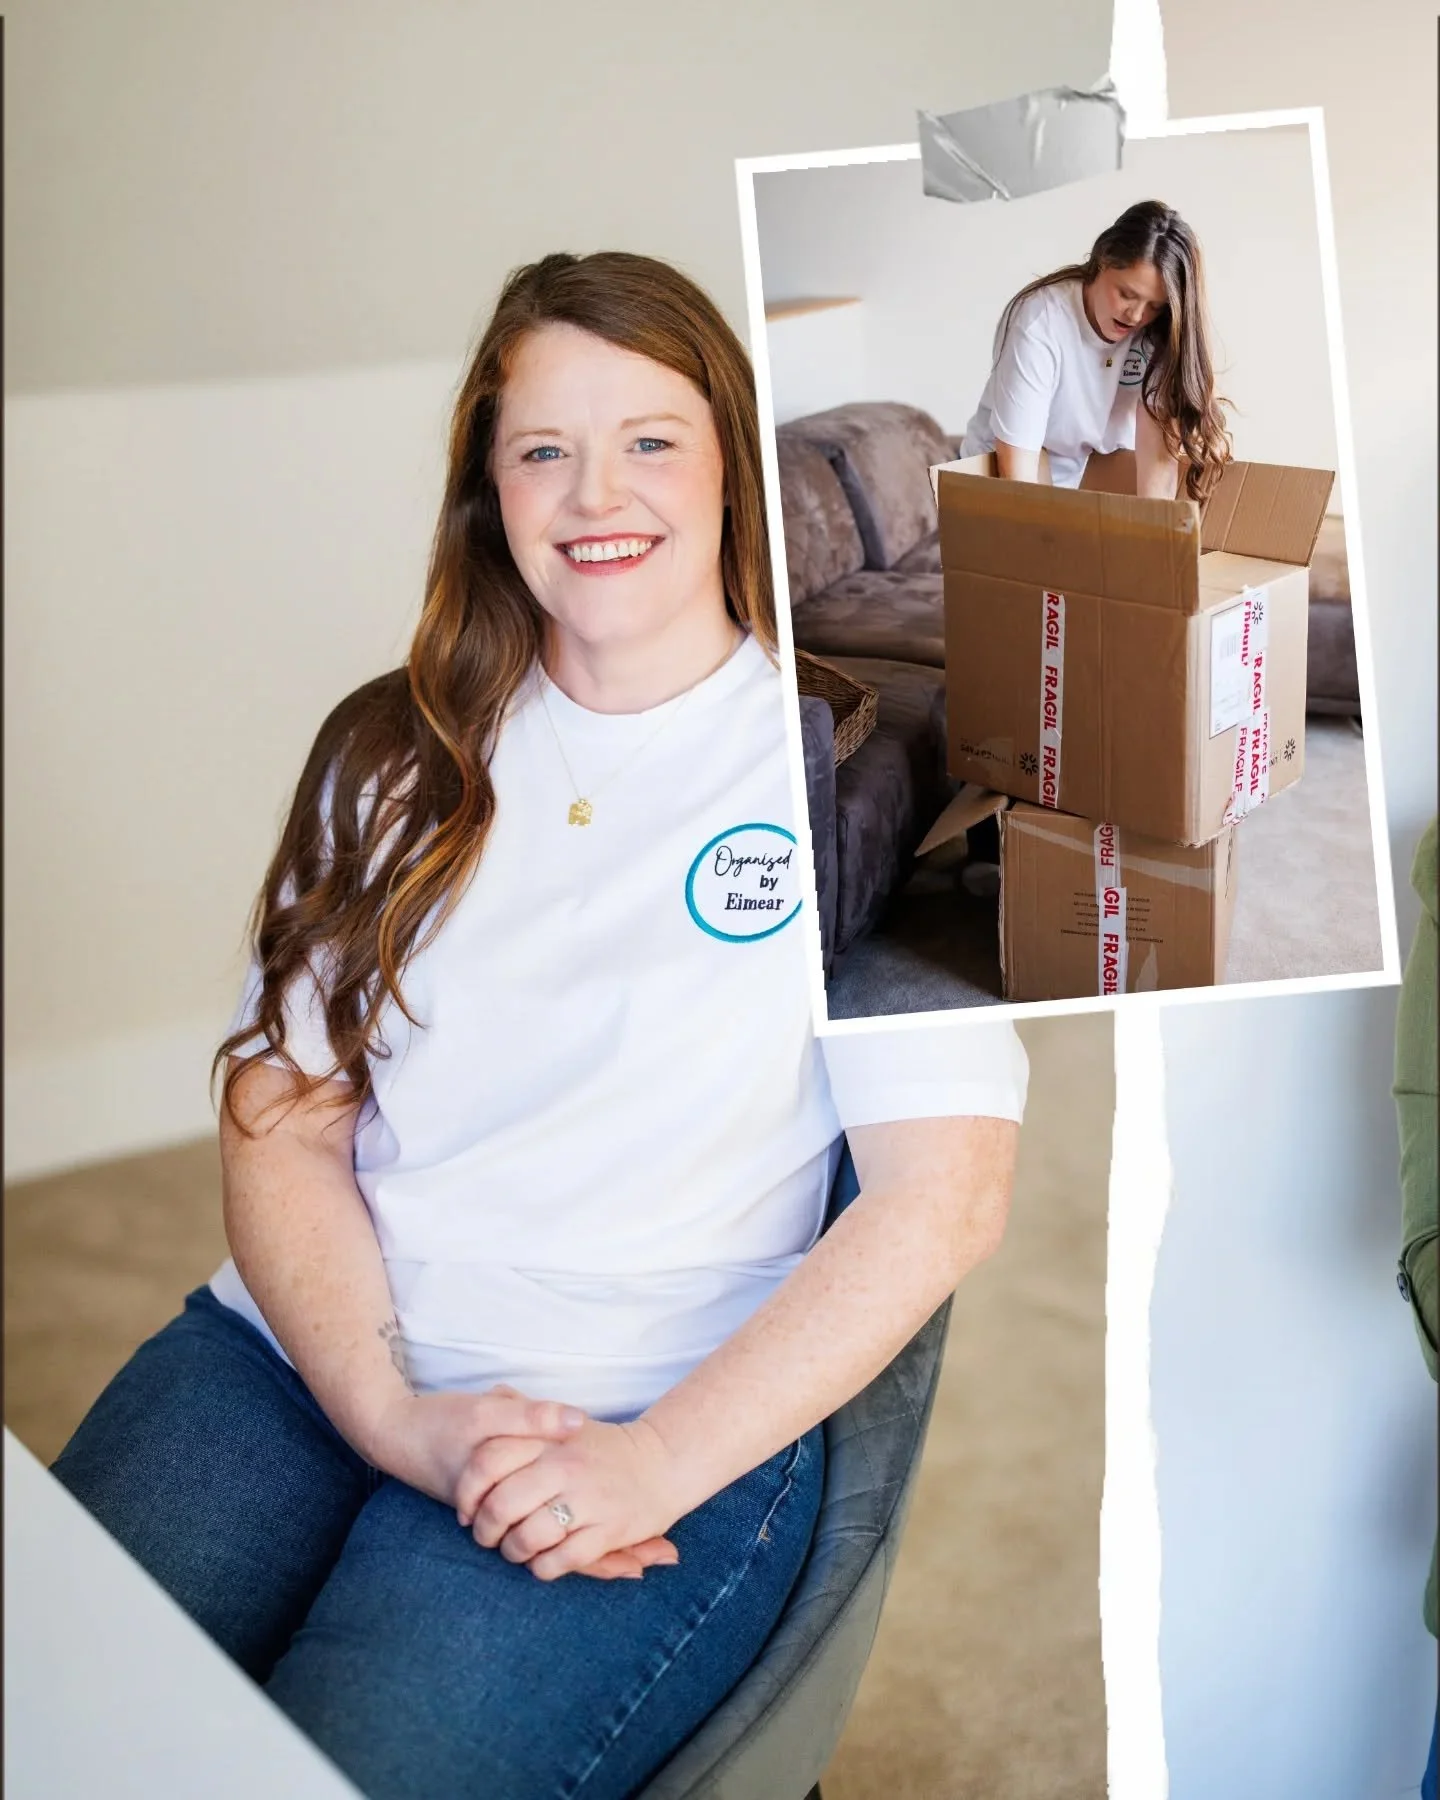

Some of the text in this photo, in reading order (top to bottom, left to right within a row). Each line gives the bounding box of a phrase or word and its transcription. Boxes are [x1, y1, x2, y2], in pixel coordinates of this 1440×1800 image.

[1044, 665, 1058, 731] FRAGIL
[1250, 653, 1263, 796] RAGIL FRAGIL
[724, 892, 784, 911] Eimear
[760, 875, 778, 891] by
